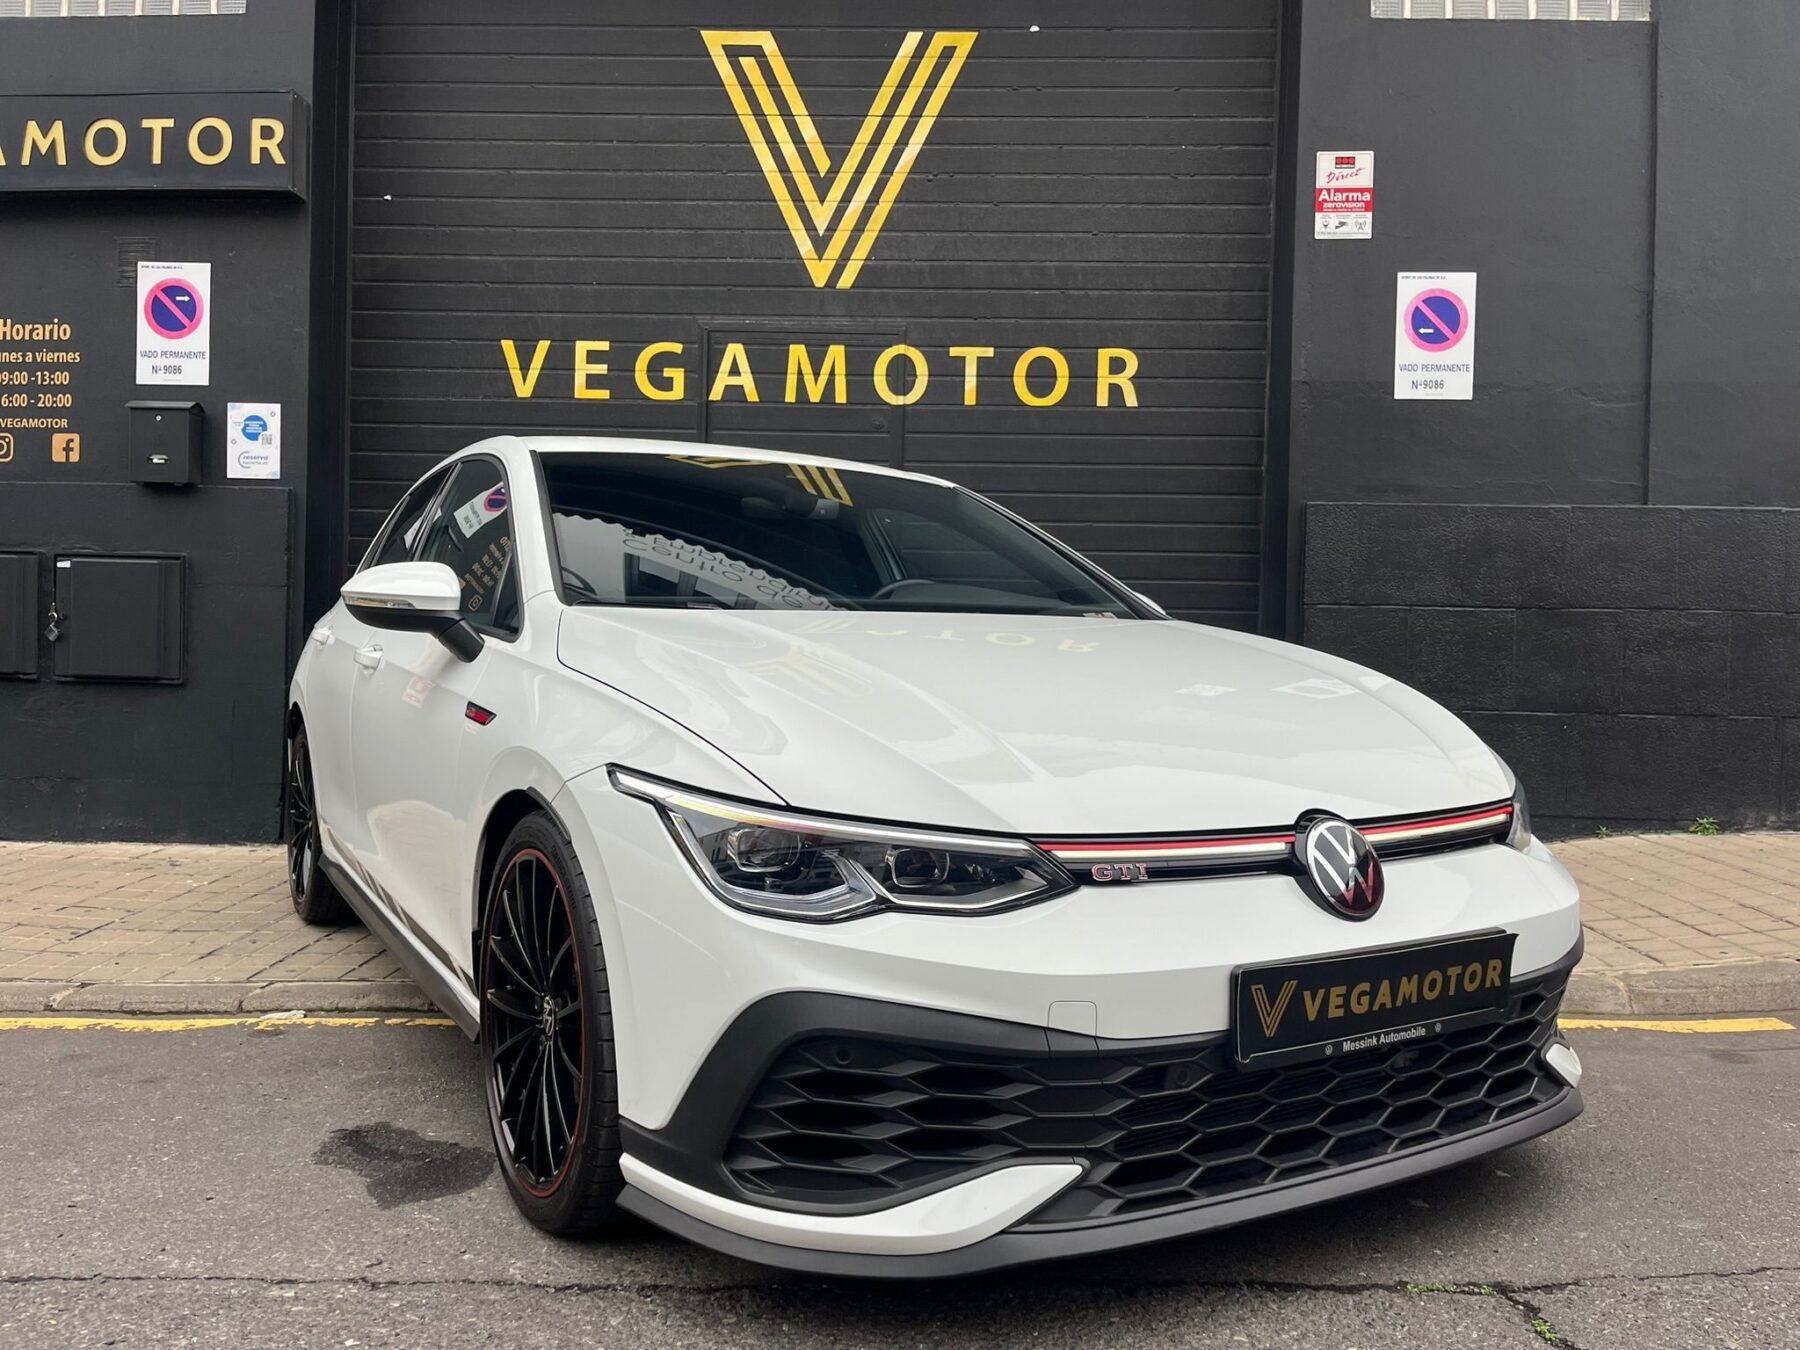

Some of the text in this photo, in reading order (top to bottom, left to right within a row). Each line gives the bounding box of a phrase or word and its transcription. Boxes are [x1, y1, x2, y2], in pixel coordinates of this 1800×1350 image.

[0, 116, 286, 166] MOTOR
[1318, 188, 1370, 202] Alarma
[0, 317, 71, 341] Horario
[0, 348, 81, 363] nes a viernes
[140, 350, 207, 360] VADO PERMANENTE
[500, 339, 1140, 407] VEGAMOTOR
[1399, 363, 1470, 373] VADO PERMANENTE
[0, 371, 28, 385] 9:00
[37, 393, 73, 407] 20:00
[0, 417, 68, 429] VEGAMOTOR
[1091, 863, 1149, 881] GTI
[1303, 958, 1503, 1022] VEGAMOTOR
[1342, 1036, 1378, 1052] Messink
[1379, 1026, 1427, 1045] Automobile
